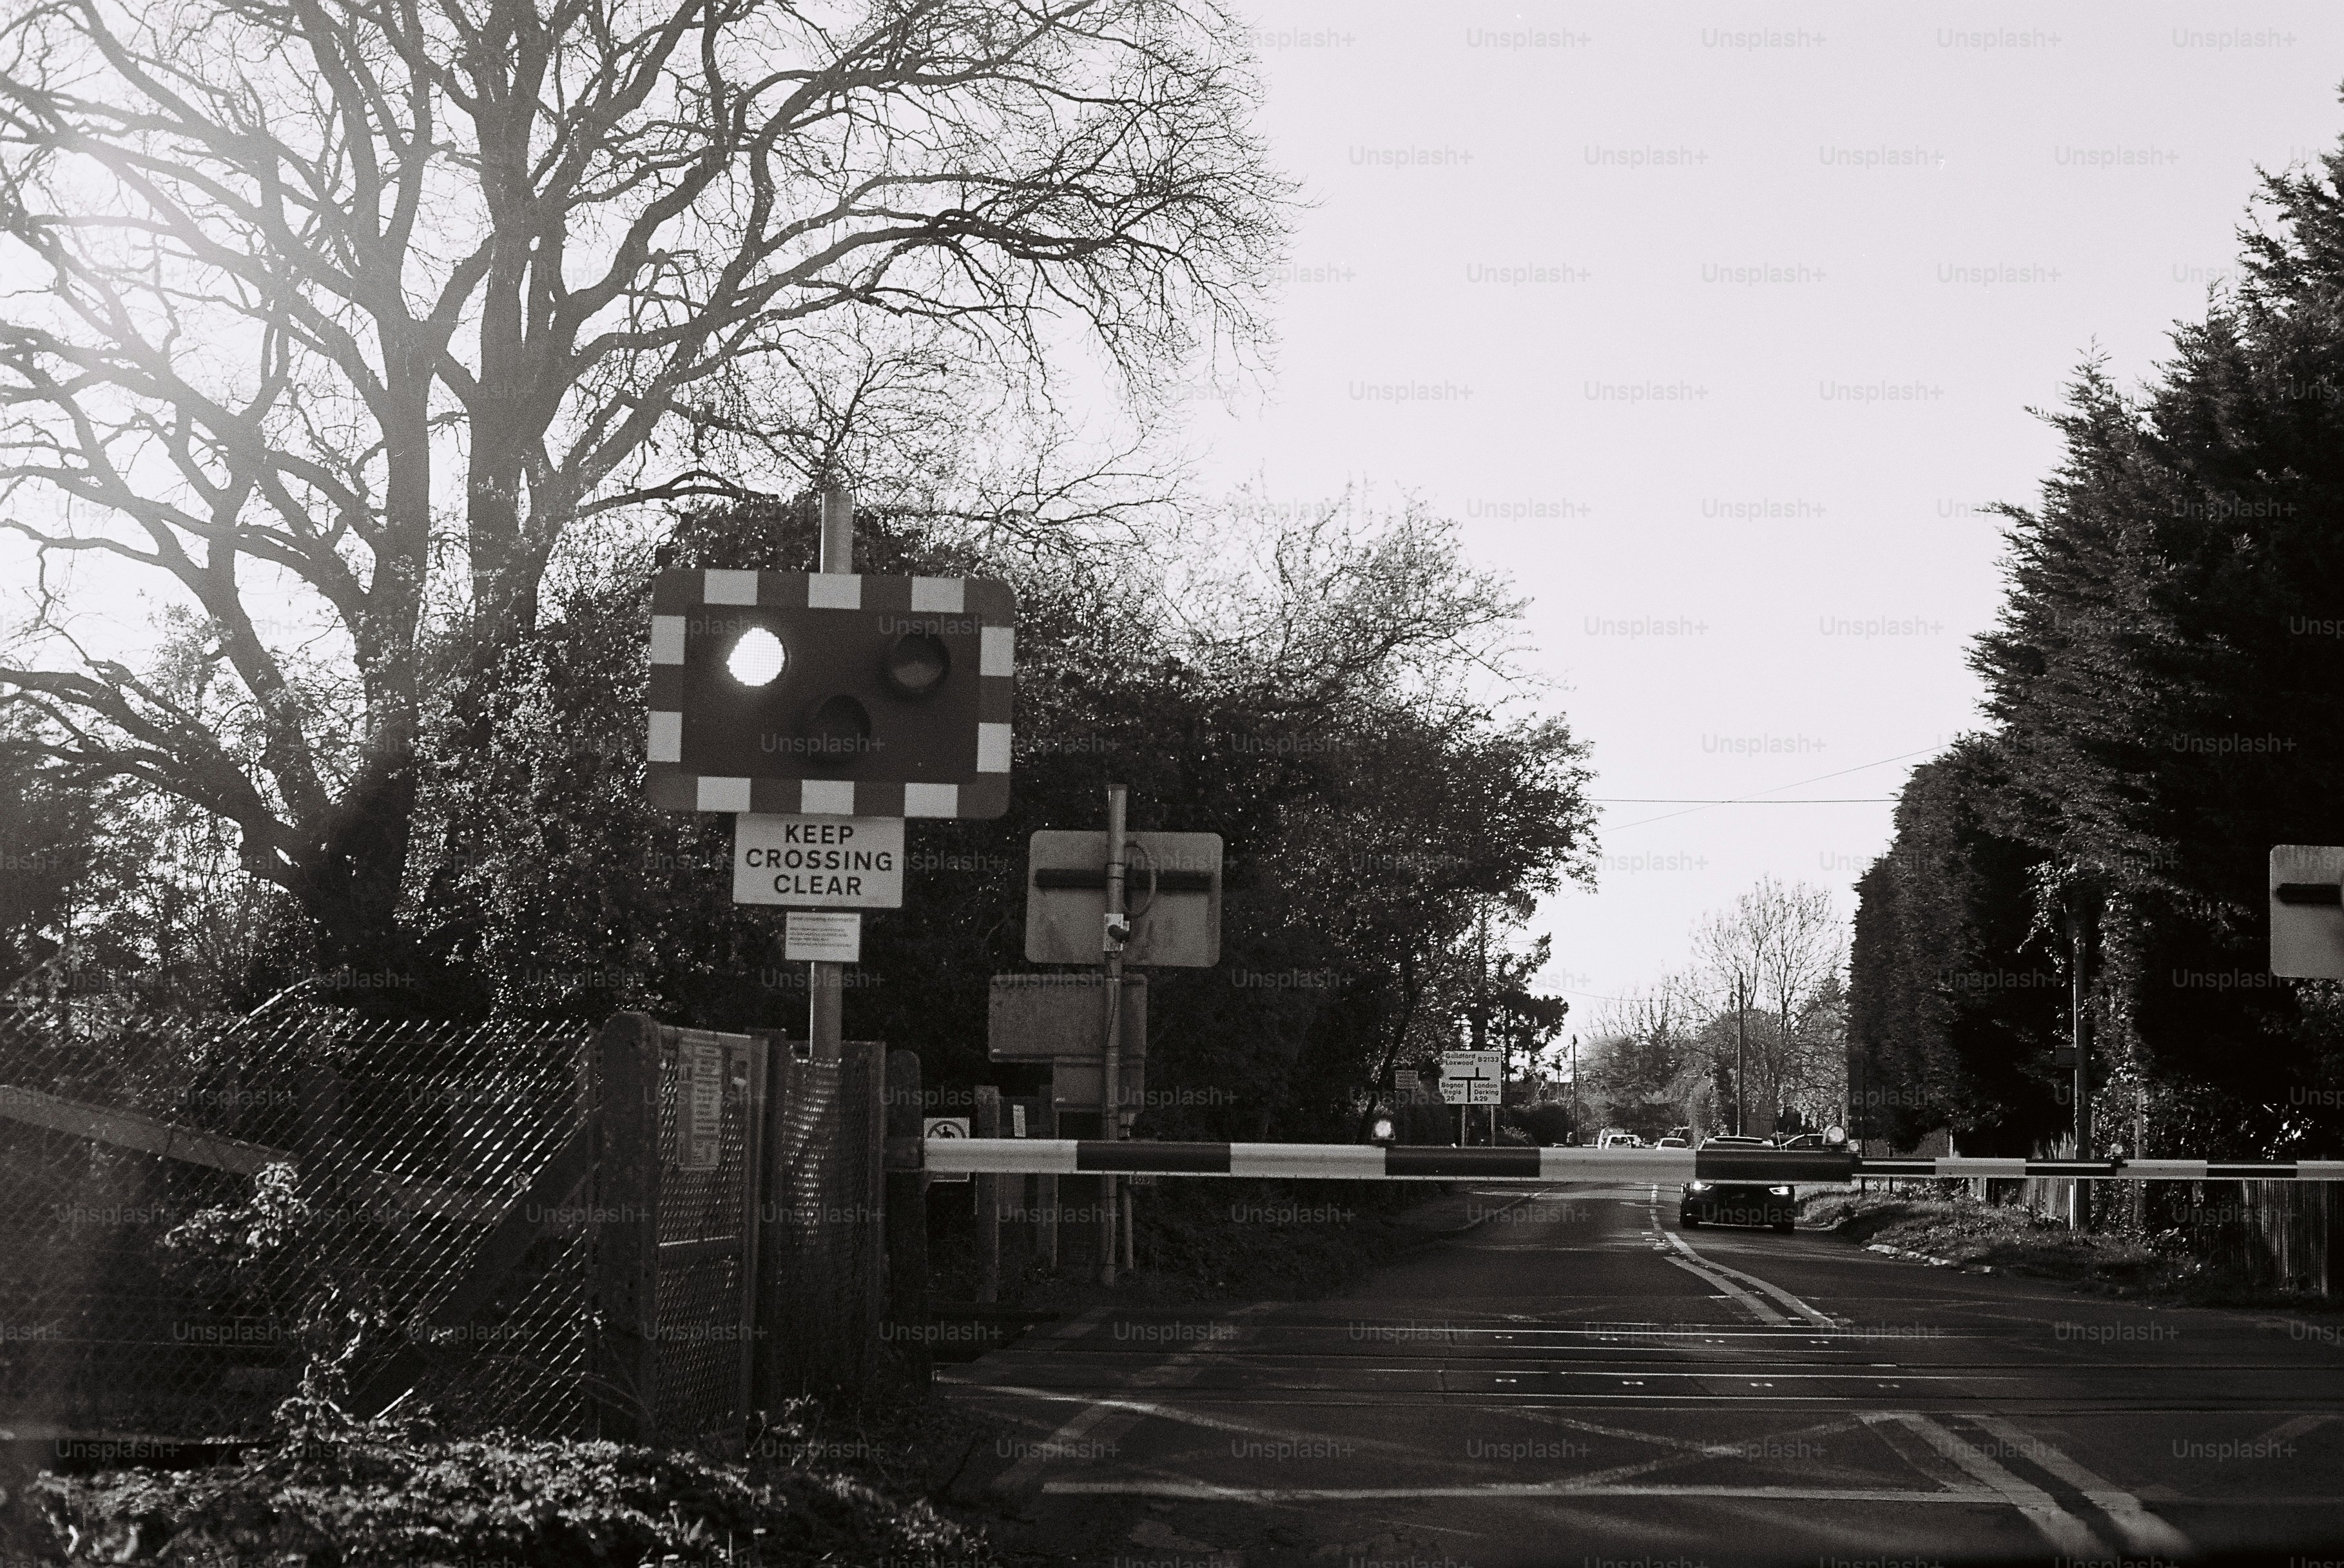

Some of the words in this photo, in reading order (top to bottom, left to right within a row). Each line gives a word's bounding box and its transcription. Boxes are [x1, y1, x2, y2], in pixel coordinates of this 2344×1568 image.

[785, 824, 855, 844] KEEP
[746, 848, 893, 871] CROSSING
[773, 874, 862, 896] CLEAR
